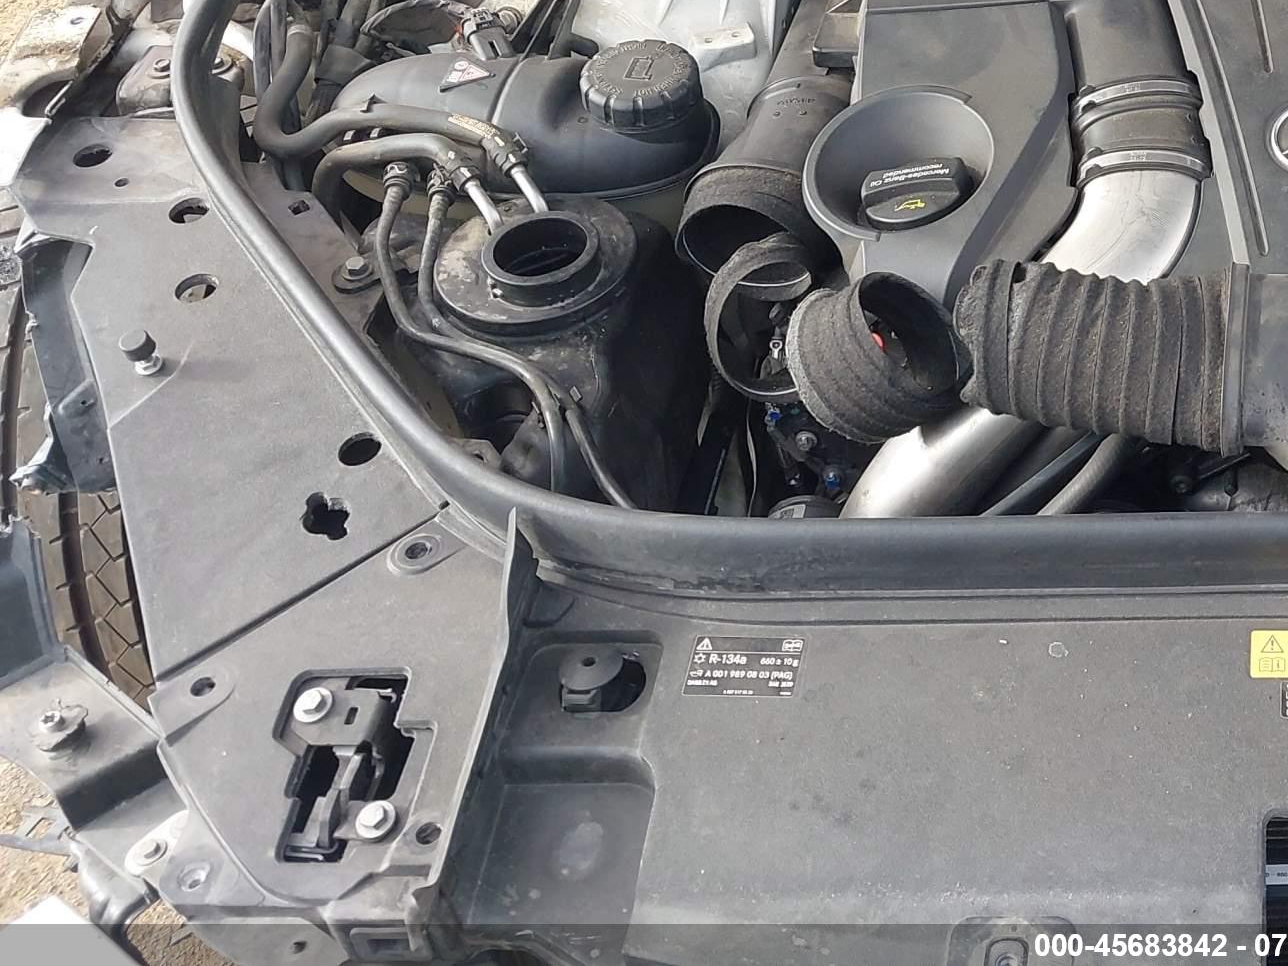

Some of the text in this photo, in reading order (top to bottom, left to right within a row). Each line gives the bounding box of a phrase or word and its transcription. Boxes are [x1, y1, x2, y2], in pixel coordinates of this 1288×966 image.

[883, 163, 943, 178] recommended
[884, 168, 949, 183] Mercedes-Benz
[708, 653, 747, 665] R-134a
[704, 669, 712, 678] A
[712, 669, 729, 678] 001
[770, 671, 793, 681] (PAG)
